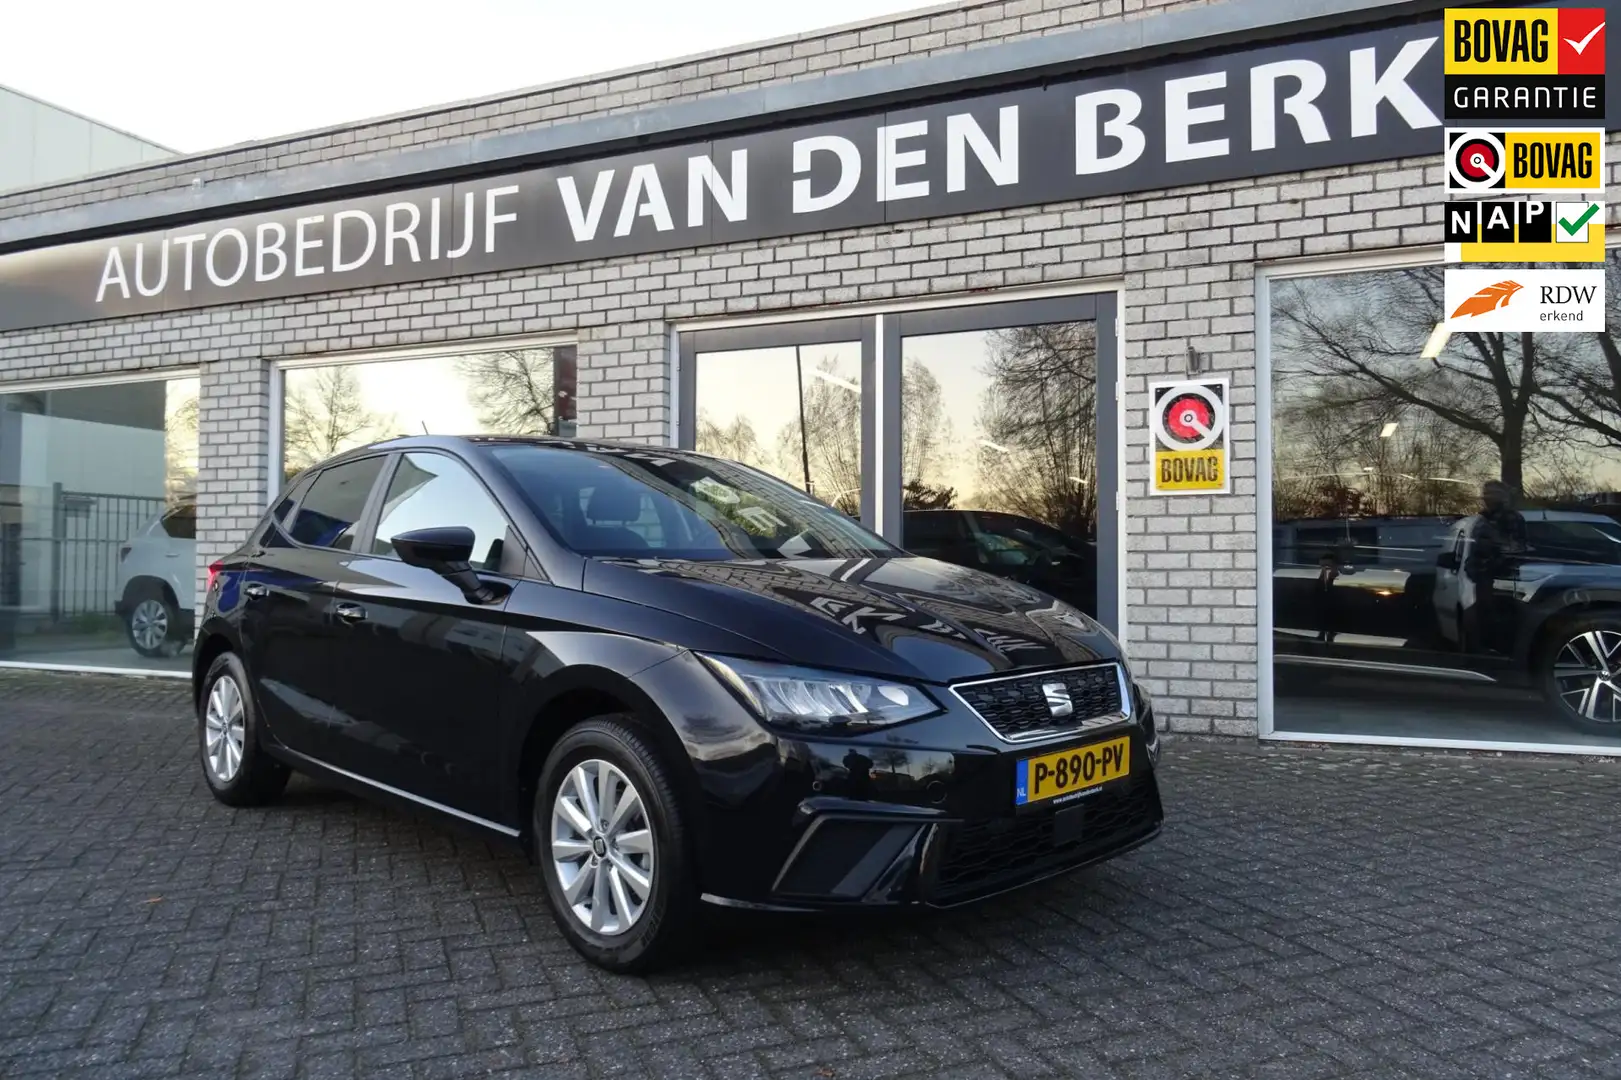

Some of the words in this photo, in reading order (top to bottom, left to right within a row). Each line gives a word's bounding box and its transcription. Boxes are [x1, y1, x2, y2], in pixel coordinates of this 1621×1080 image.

[95, 185, 520, 302] AUTOBEDRIJF
[556, 149, 749, 242] VAN
[792, 105, 1020, 214] DEN
[1075, 36, 1444, 176] BERK
[1160, 456, 1218, 482] BOVAG
[1034, 743, 1124, 795] P-890-PV
[1016, 787, 1026, 797] NL
